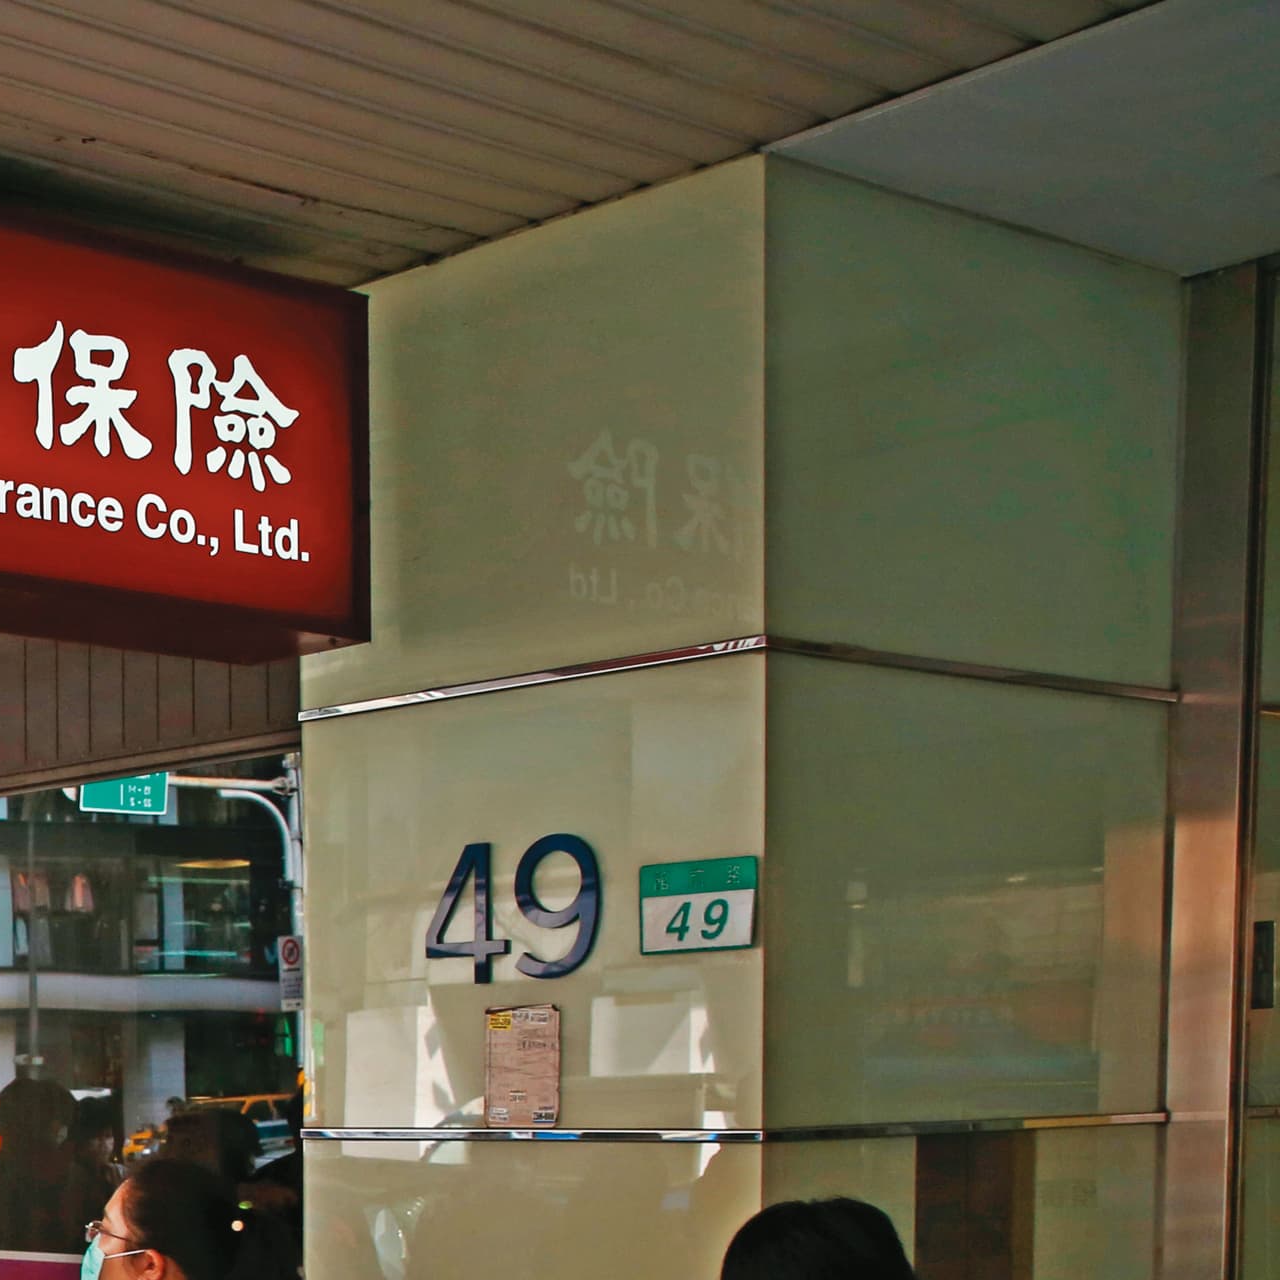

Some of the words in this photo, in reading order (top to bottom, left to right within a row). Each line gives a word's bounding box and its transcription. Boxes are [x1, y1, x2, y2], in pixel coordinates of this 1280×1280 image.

[137, 493, 221, 557] Co.,
[233, 509, 312, 563] Ltd.
[425, 832, 603, 984] 49
[665, 898, 729, 942] 49
